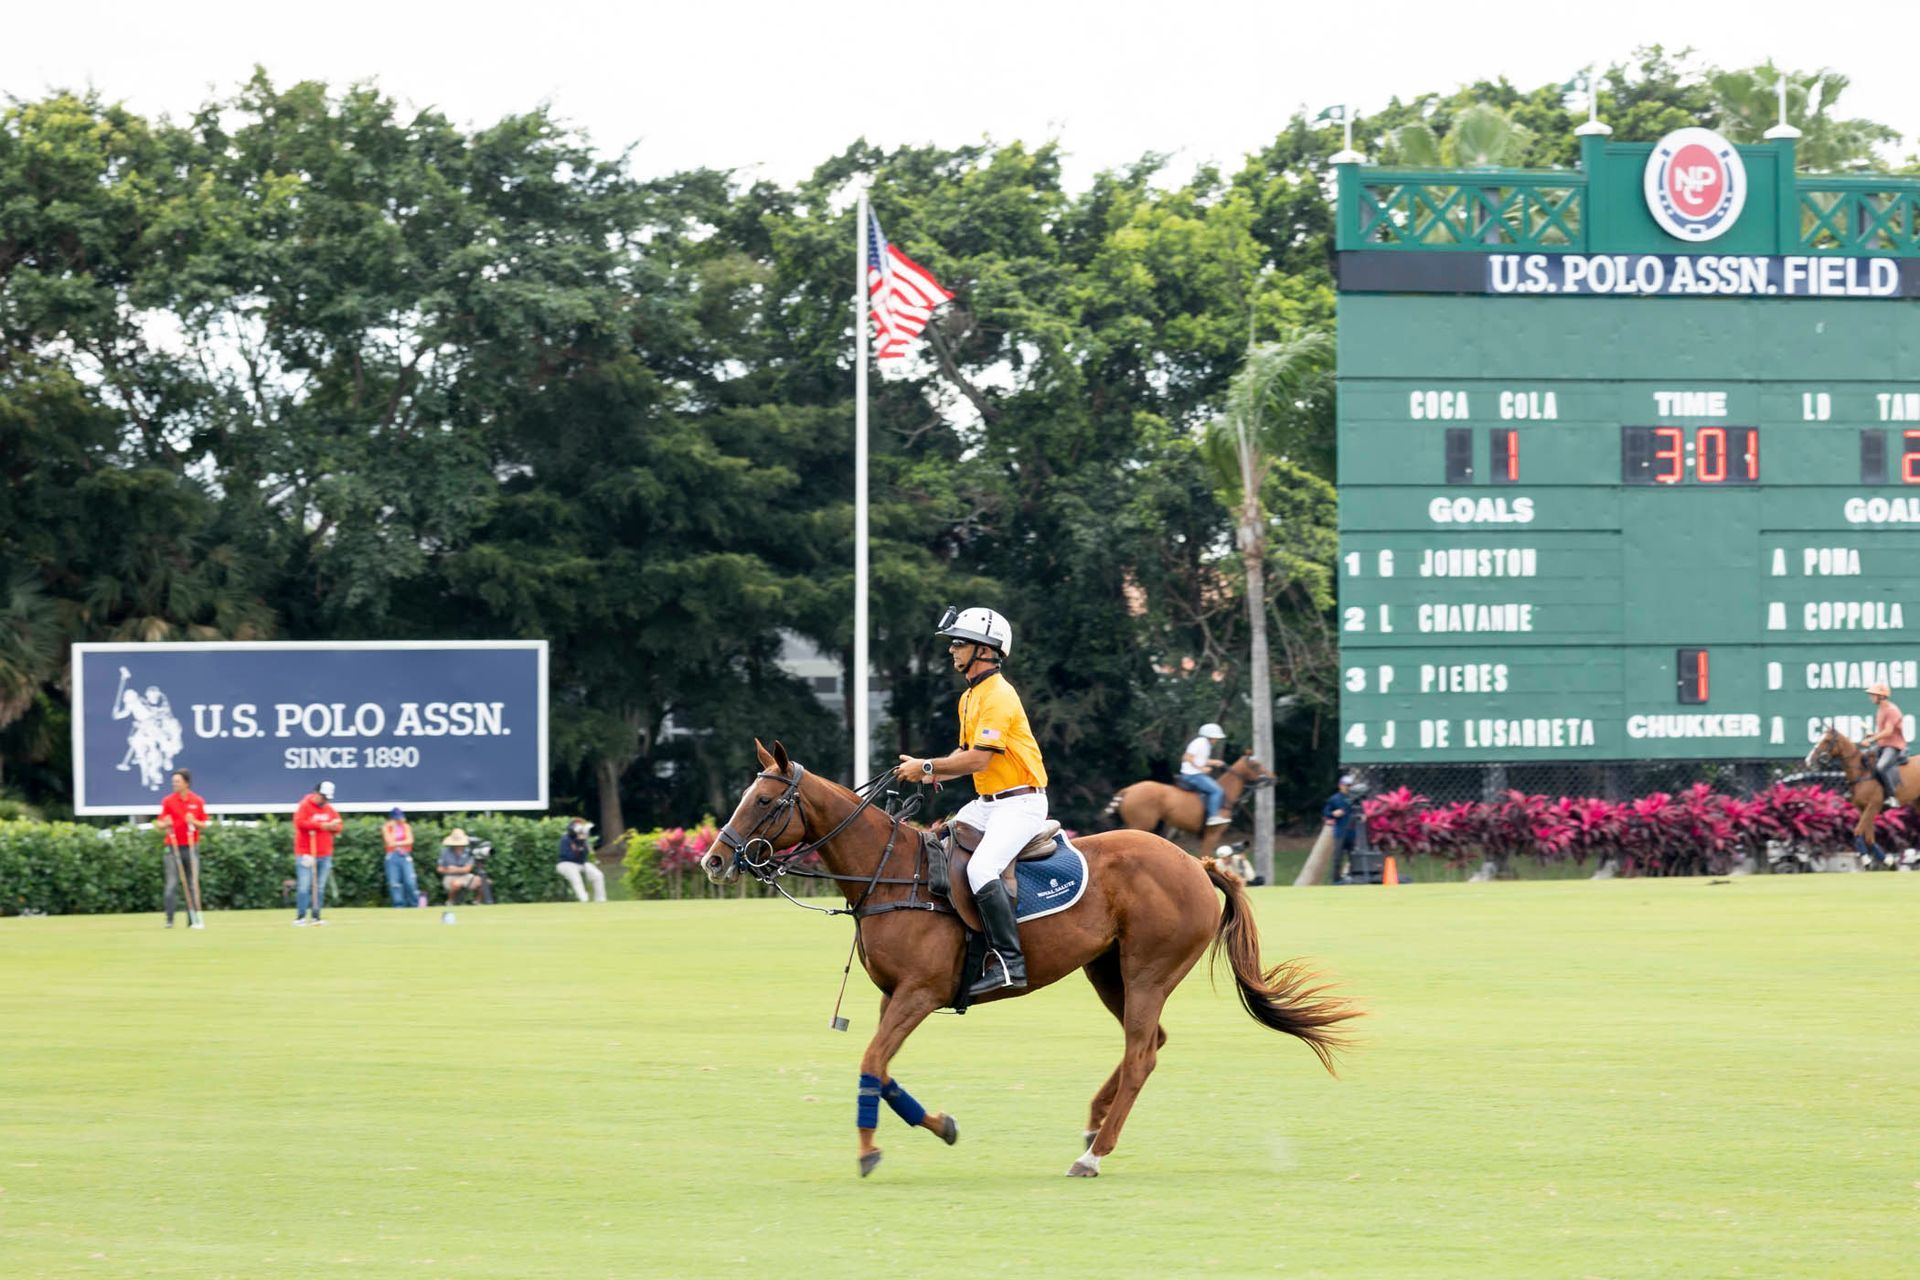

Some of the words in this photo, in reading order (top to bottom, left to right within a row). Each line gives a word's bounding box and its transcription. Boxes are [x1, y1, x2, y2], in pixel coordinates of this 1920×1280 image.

[1489, 255, 1557, 292] U.S.
[1562, 255, 1664, 293] POLO
[1668, 256, 1777, 294] ASSN.
[1784, 257, 1898, 295] FIELD
[1410, 391, 1469, 420] COCA
[1500, 391, 1557, 420] COLA
[1653, 392, 1727, 416] TIME
[1508, 431, 1519, 480] 1
[1655, 427, 1759, 483] 3:01
[1429, 497, 1535, 523] GOALS
[1345, 552, 1361, 576] 1
[1379, 550, 1394, 577] G
[1420, 549, 1536, 577] JOHNSTON
[1772, 548, 1787, 576] A
[1344, 607, 1365, 631] 2
[1380, 604, 1393, 632] L
[1419, 604, 1532, 632] CHAVANNE
[1804, 602, 1904, 631] COPPOLA
[1345, 667, 1366, 692] 3
[1379, 665, 1394, 693] P
[1420, 664, 1508, 693] PIERES
[1698, 651, 1708, 701] 1
[191, 704, 265, 738] U.S.
[275, 703, 385, 737] POLO
[393, 702, 511, 736] ASSN.
[1345, 723, 1367, 747] 4
[1381, 720, 1395, 748] J
[1420, 720, 1449, 748] DE
[1465, 719, 1594, 747] LUSARRETA
[1627, 714, 1761, 738] CHUKKER
[1770, 716, 1785, 744] A
[284, 747, 357, 769] SINCE
[363, 746, 420, 768] 1890
